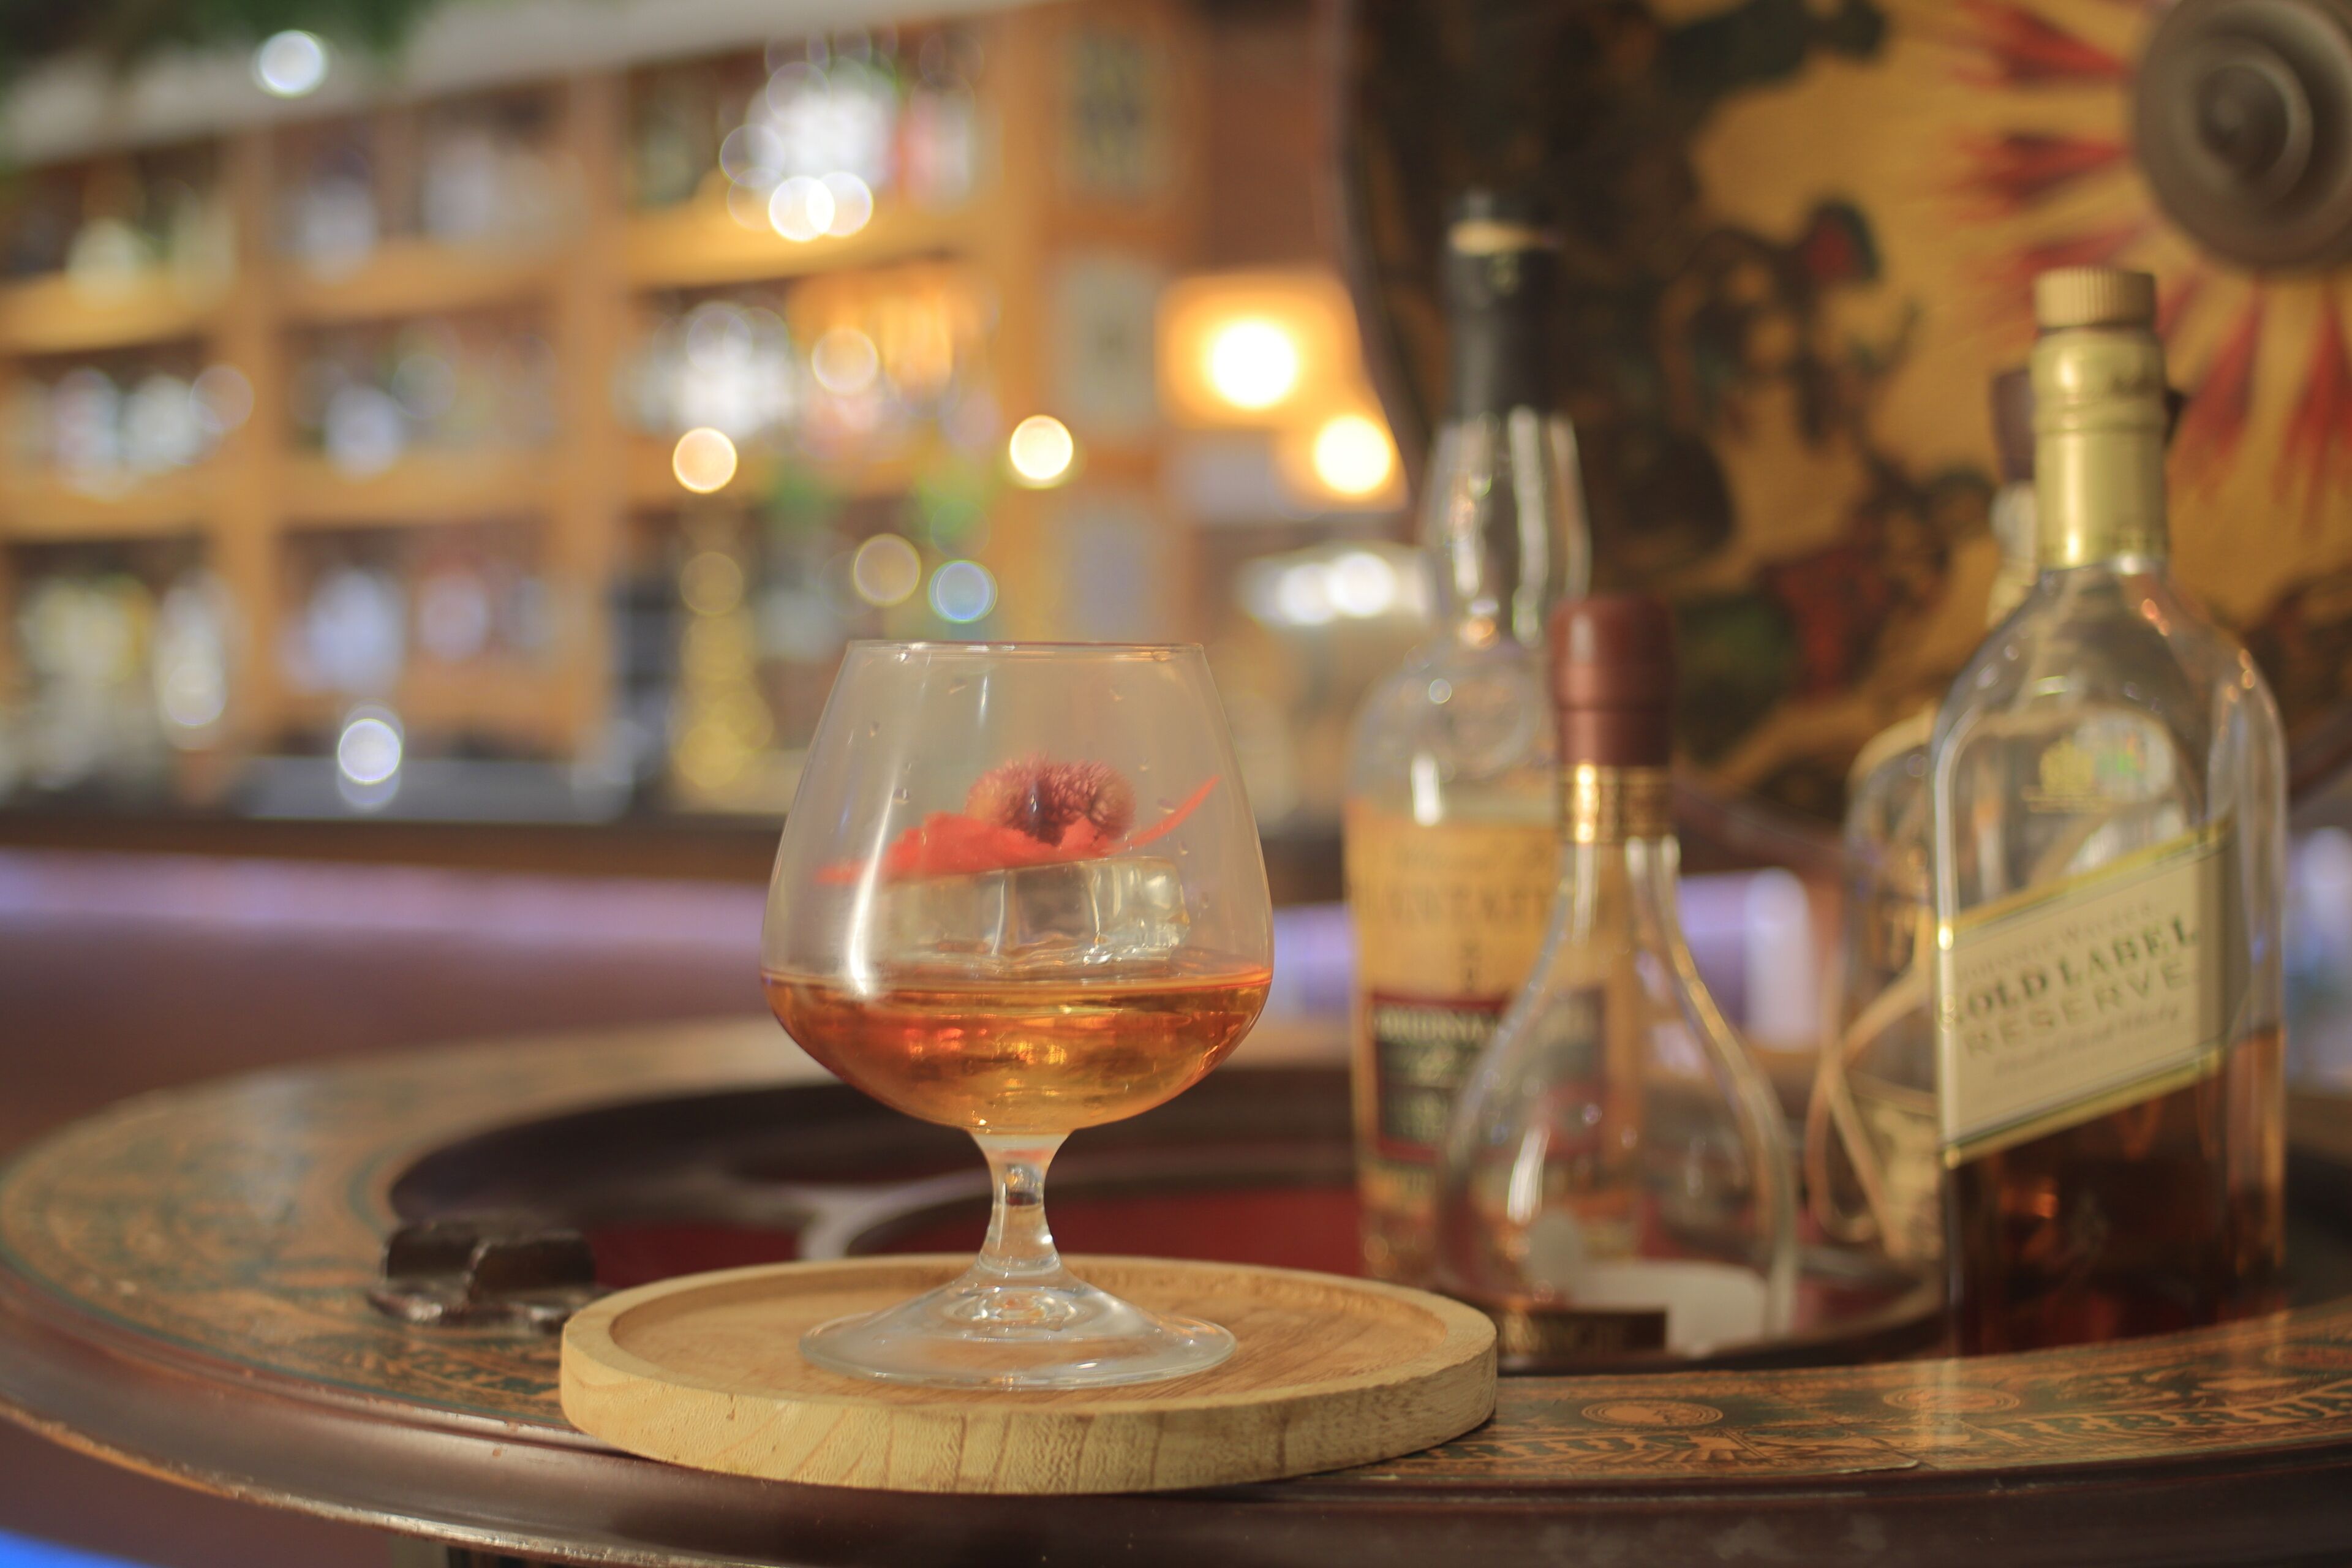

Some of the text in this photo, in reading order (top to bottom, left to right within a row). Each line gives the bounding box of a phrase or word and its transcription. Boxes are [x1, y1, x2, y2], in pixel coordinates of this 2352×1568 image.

[1948, 964, 2049, 1027] OLD
[2056, 913, 2200, 990] LABEL
[1964, 958, 2192, 1058] RESERVE
